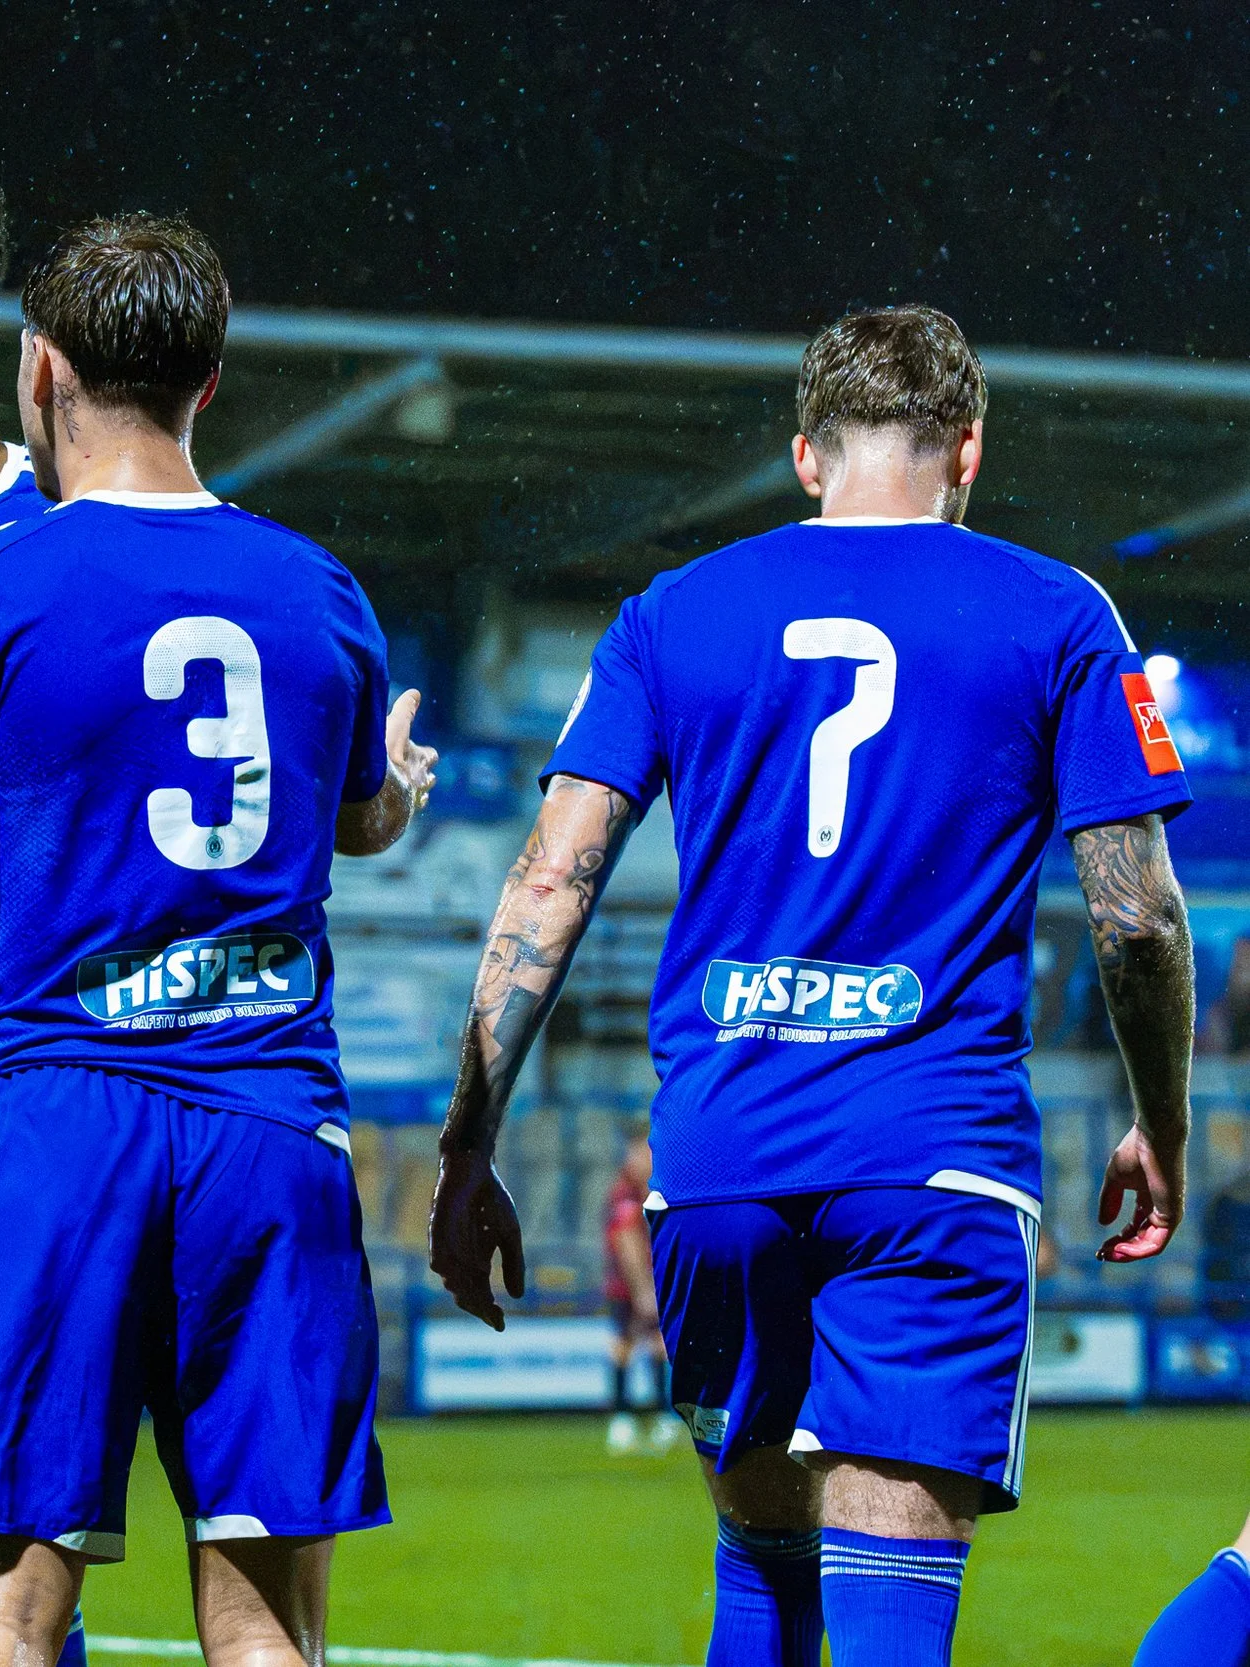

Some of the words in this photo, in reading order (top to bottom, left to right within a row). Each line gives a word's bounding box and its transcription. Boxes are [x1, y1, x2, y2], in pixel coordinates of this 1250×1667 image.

[143, 616, 271, 870] 3
[783, 617, 897, 858] 7
[131, 1014, 176, 1029] SAFETY
[187, 1007, 233, 1026] HOUSING
[234, 1003, 297, 1017] SOLUTIONS
[778, 1027, 828, 1043] HOUSING
[829, 1028, 888, 1042] SOLUTIONS
